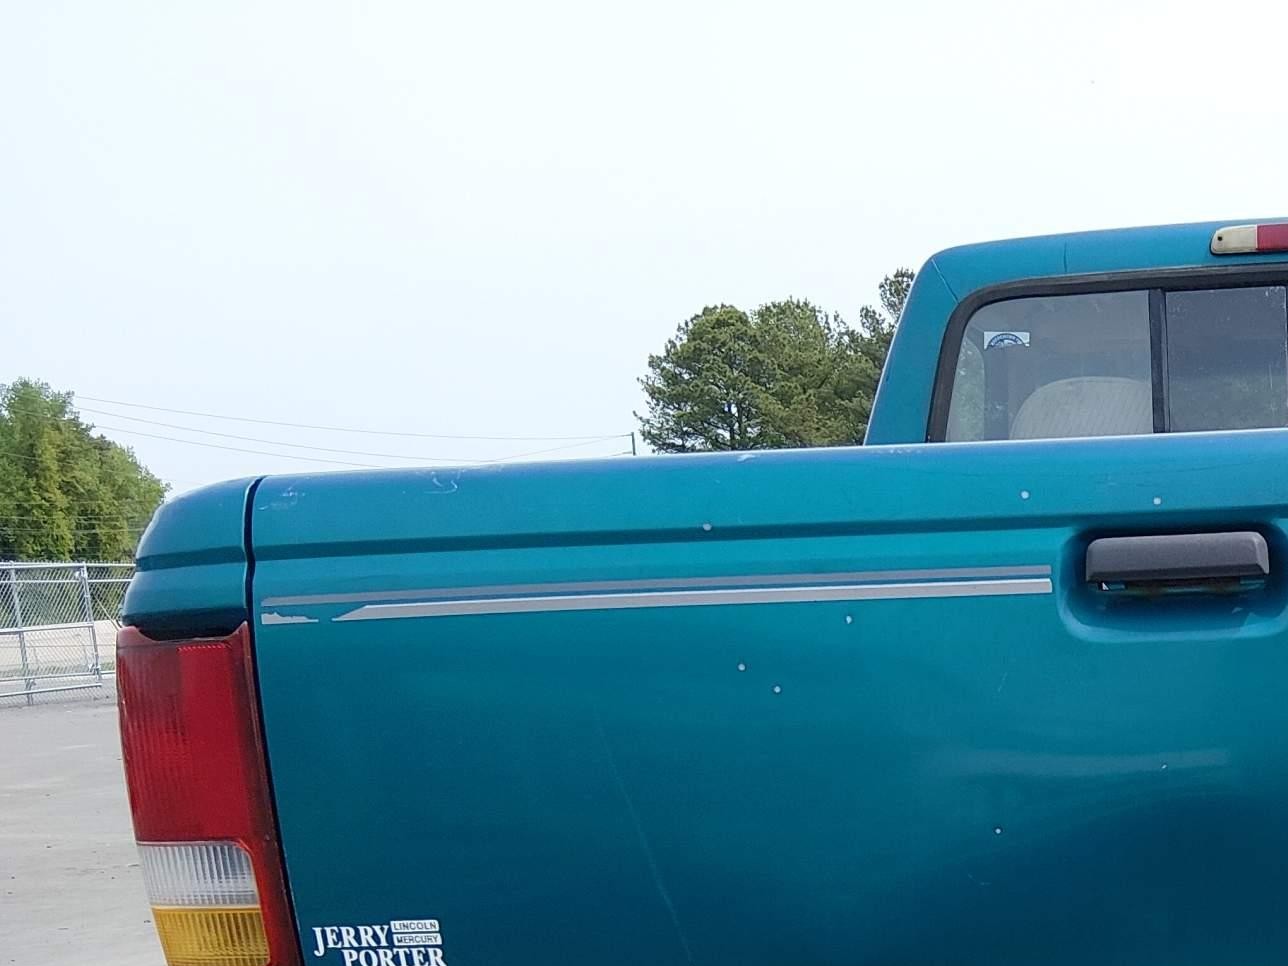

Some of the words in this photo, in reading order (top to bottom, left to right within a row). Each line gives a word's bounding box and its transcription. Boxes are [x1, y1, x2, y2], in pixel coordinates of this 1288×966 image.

[393, 921, 437, 931] LINCOLN
[312, 925, 389, 957] JERRY
[397, 934, 438, 944] MERCURY
